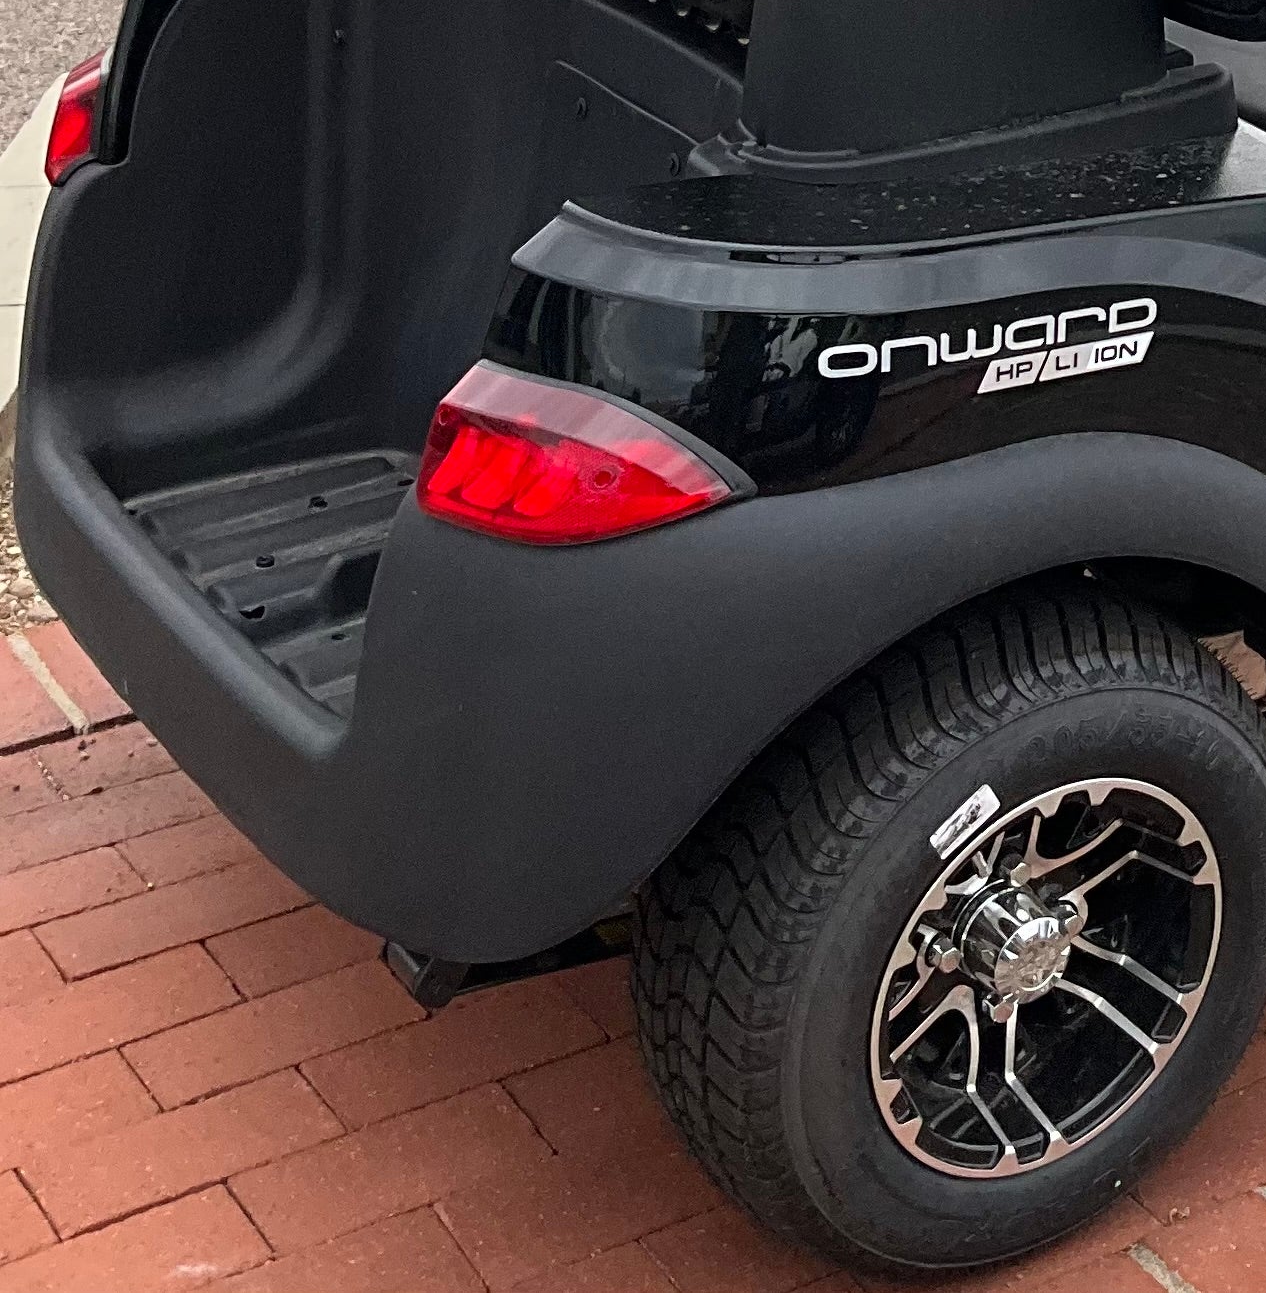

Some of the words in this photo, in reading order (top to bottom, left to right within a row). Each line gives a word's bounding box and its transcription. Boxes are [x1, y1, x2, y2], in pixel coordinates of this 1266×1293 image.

[995, 360, 1033, 383] HP
[1055, 352, 1078, 371] LI
[1094, 340, 1138, 364] ION
